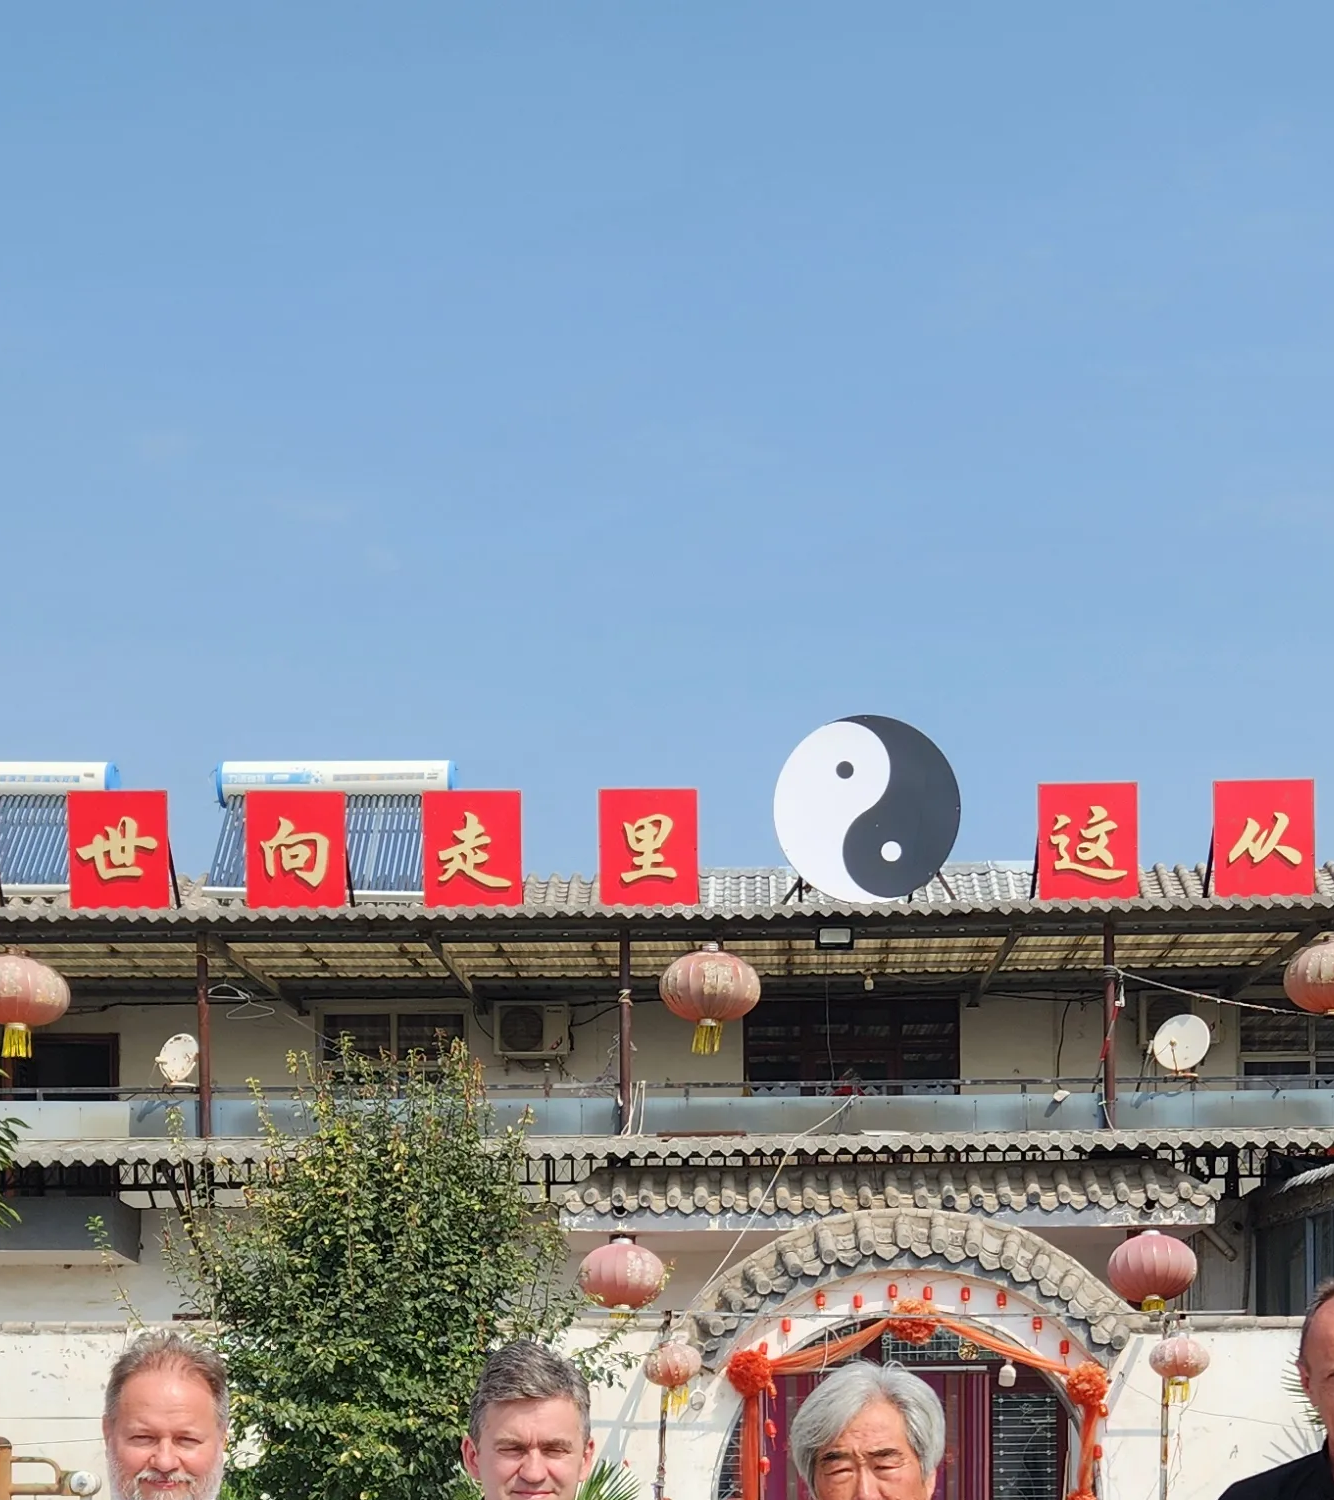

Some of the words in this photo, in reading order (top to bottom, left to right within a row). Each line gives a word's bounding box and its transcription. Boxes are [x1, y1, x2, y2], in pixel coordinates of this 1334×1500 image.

[76, 816, 159, 880] 世
[260, 816, 330, 887] 向
[438, 811, 513, 888] 走
[620, 813, 678, 883] 里
[1050, 805, 1128, 880] 这
[1228, 811, 1303, 865] 从
